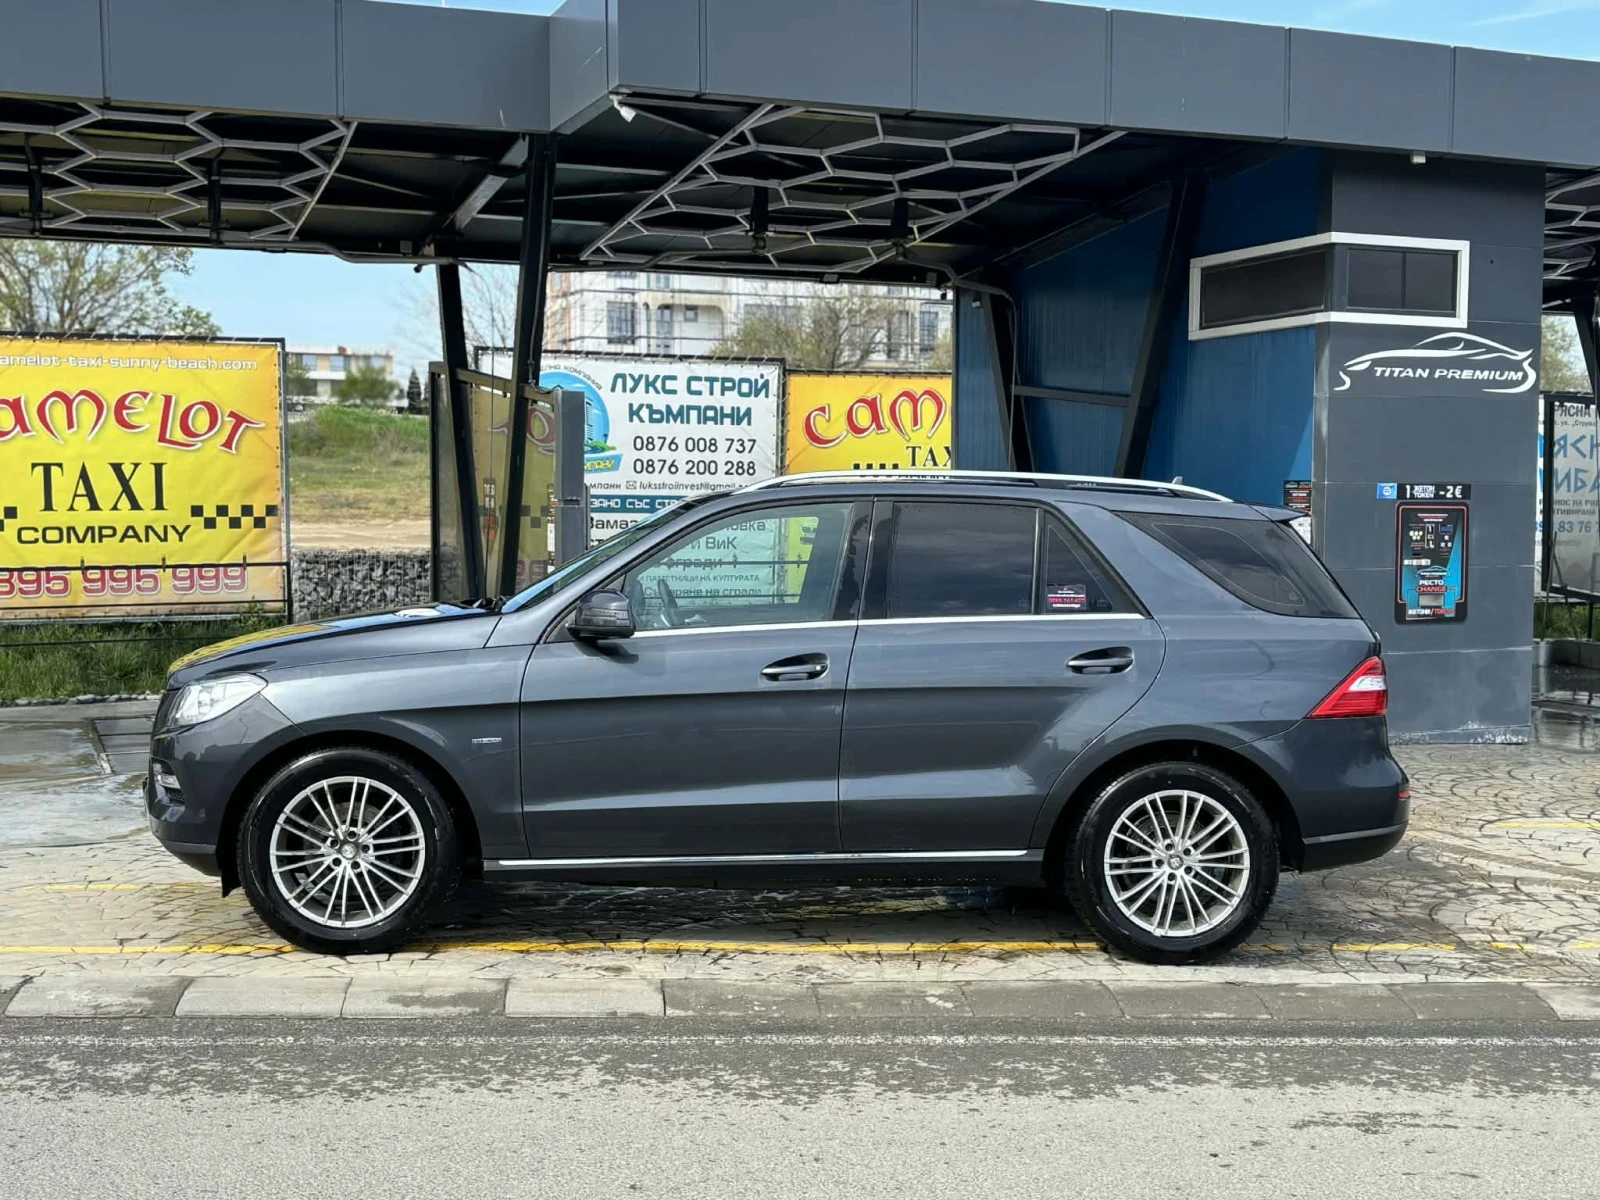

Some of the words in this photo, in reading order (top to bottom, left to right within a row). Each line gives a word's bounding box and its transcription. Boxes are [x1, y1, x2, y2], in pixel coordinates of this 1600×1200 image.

[1374, 366, 1429, 378] TITAN
[1433, 367, 1524, 381] PREMIUM
[610, 373, 678, 395] ЛУКС
[686, 373, 770, 399] СТРОЙ
[628, 403, 752, 427] КЪМПАНИ
[633, 435, 679, 452] 0876
[684, 437, 719, 453] 008
[724, 438, 757, 454] 737
[633, 458, 679, 475] 0876
[685, 459, 719, 475] 200
[724, 460, 757, 477] 288
[30, 461, 168, 512] TAXI
[1405, 485, 1411, 499] 1
[626, 499, 651, 509] СЪС
[17, 524, 192, 544] COMPANY
[1558, 520, 1575, 533] 83
[1577, 520, 1592, 533] 76
[705, 536, 738, 550] ВиК
[82, 567, 161, 597] 995
[171, 566, 248, 594] 999
[705, 587, 720, 597] на
